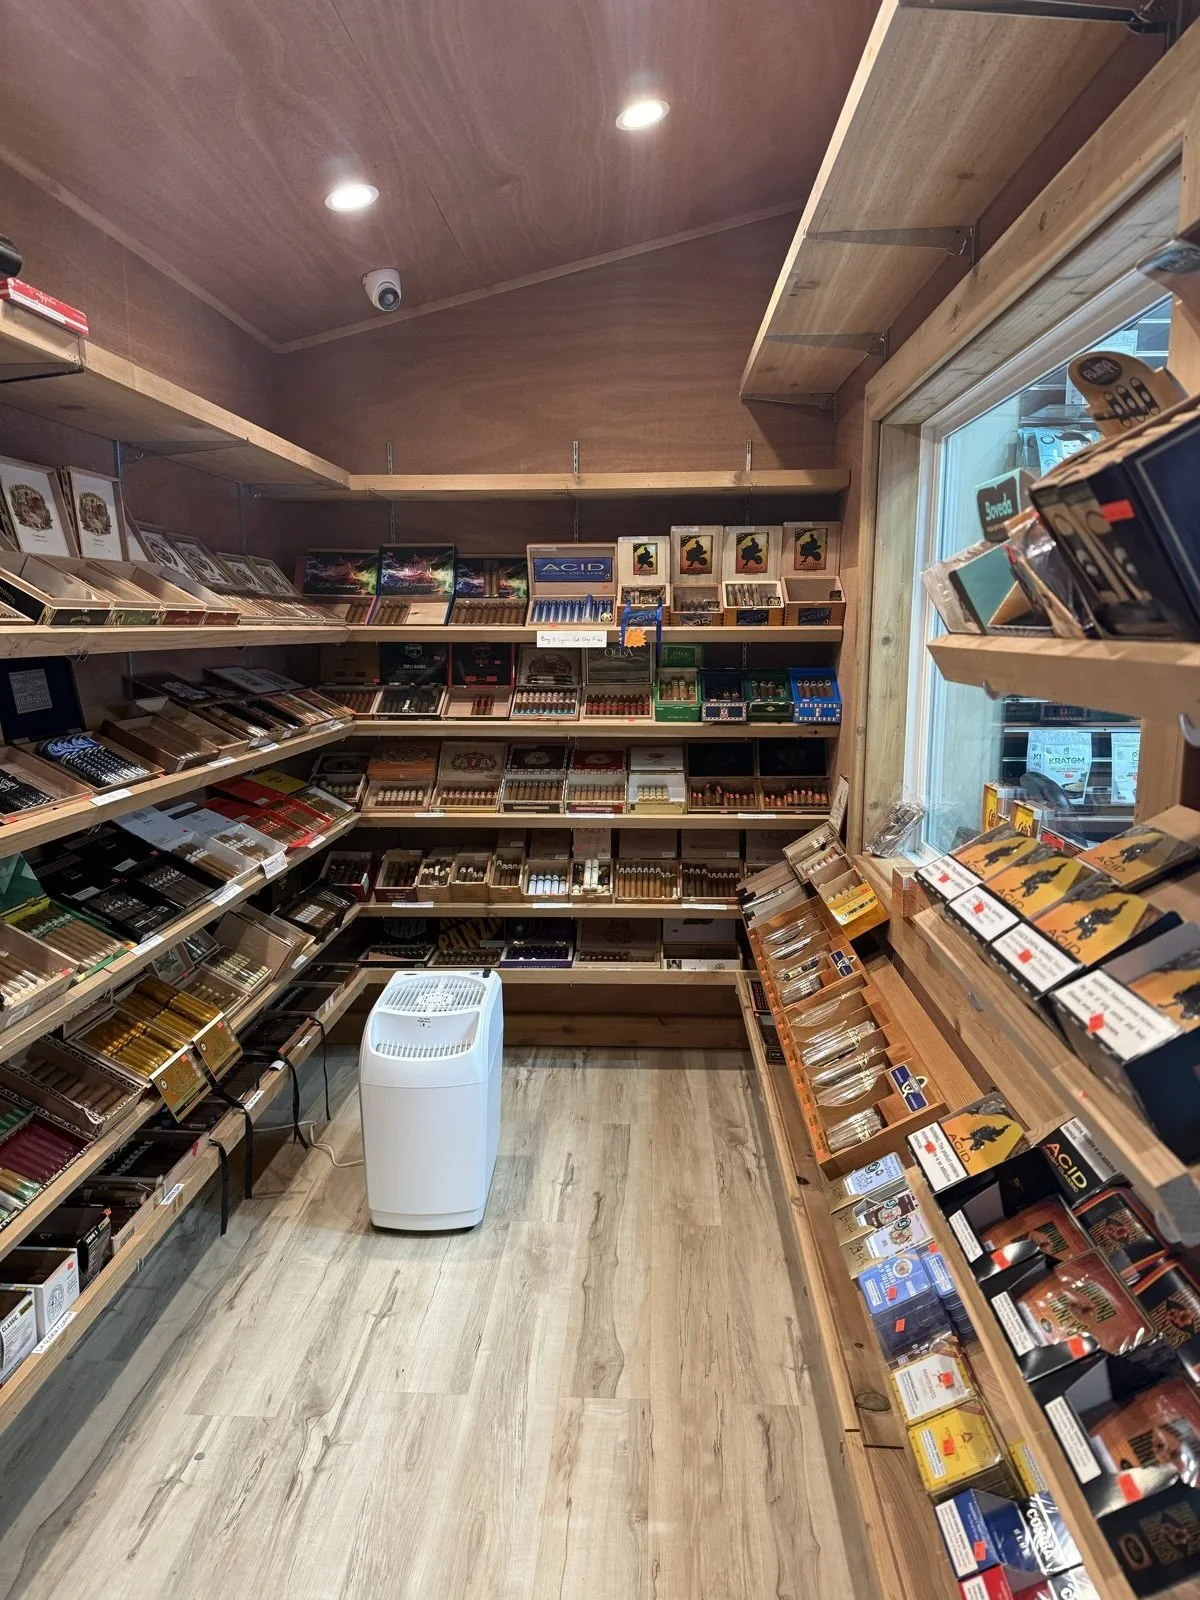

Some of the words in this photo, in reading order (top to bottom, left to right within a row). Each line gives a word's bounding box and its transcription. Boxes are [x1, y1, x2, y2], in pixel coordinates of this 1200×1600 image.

[541, 563, 605, 571] ACID
[1049, 757, 1085, 765] KRATOM
[1096, 856, 1126, 873] ACID
[997, 888, 1025, 910] ACID
[1047, 928, 1081, 956] ACID
[948, 1130, 971, 1164] ACID
[1045, 1137, 1090, 1191] ACID
[1056, 1165, 1080, 1194] CLASSIC
[1073, 1276, 1118, 1327] HAVANA
[0, 1313, 20, 1333] CLASSIC
[1046, 1291, 1089, 1341] HONEYS
